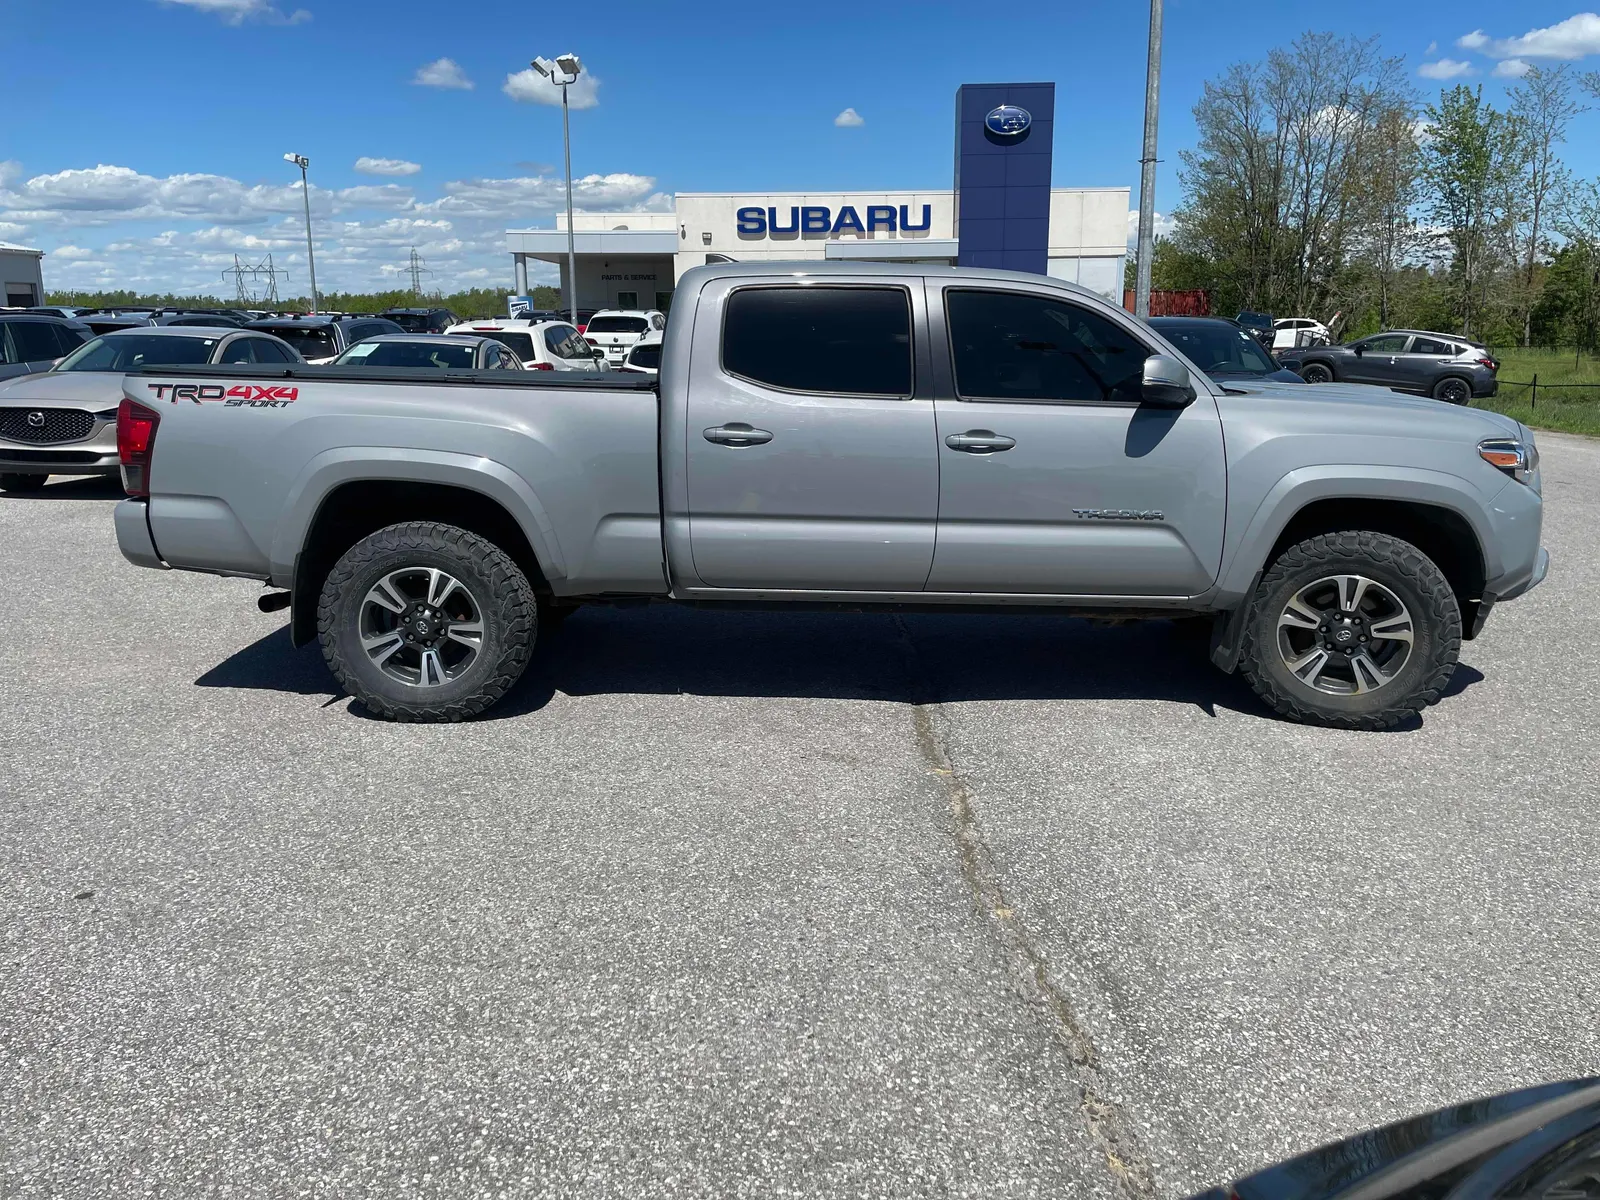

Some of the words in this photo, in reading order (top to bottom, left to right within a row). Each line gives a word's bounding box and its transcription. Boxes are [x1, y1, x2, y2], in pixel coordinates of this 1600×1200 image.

[737, 205, 931, 233] SUBARU
[148, 384, 227, 405] TRD
[224, 399, 294, 408] SPORT
[1072, 508, 1164, 520] TACOMA
